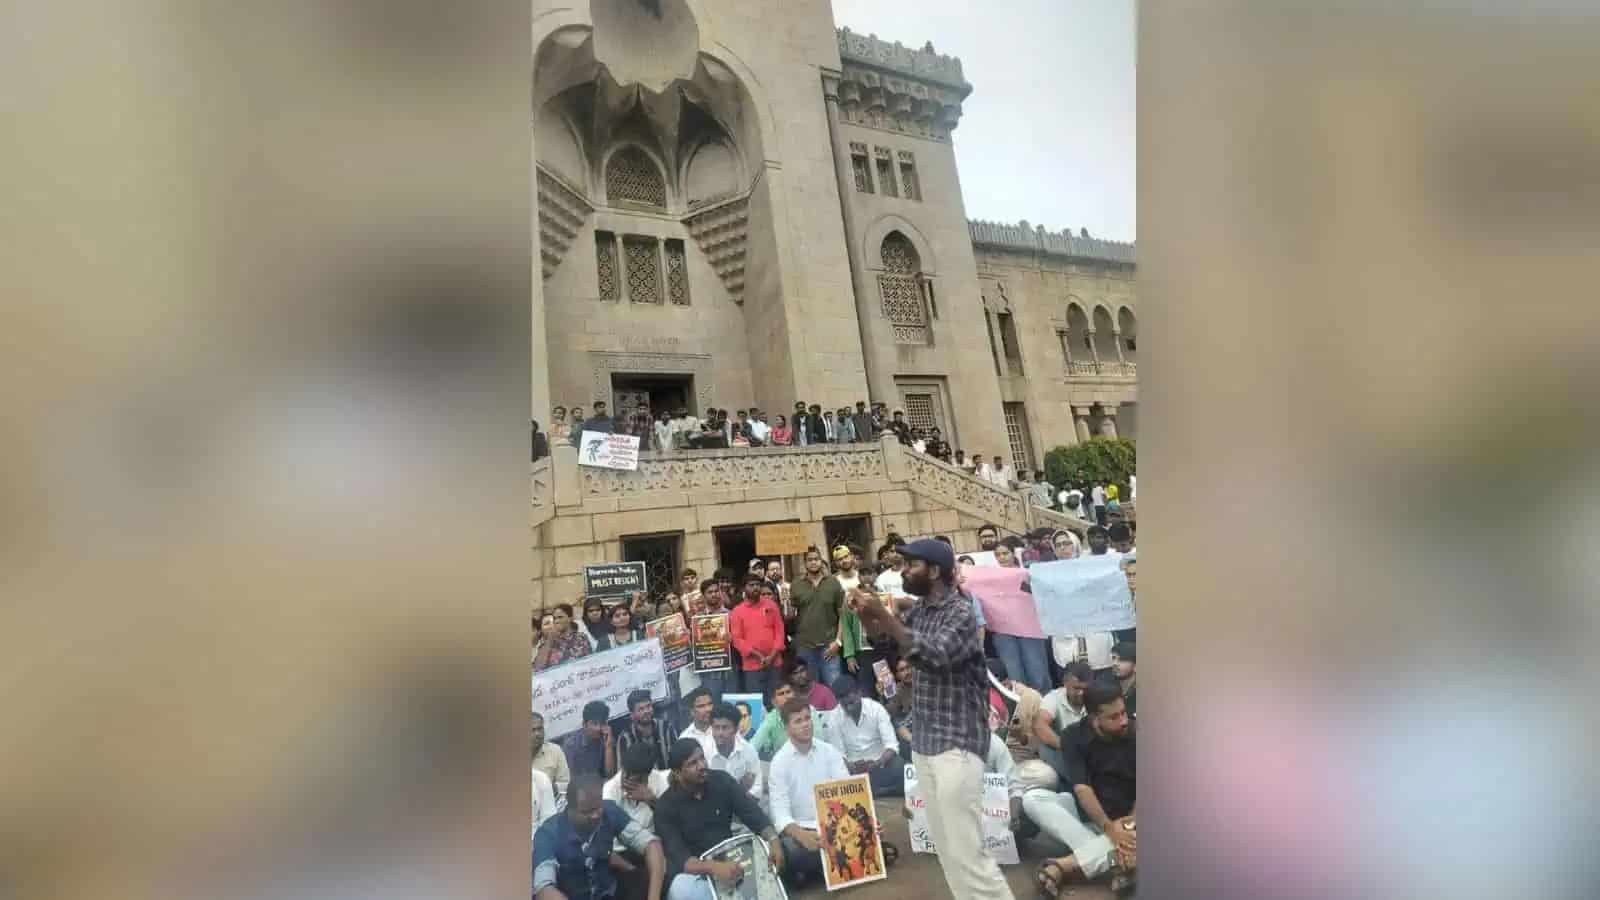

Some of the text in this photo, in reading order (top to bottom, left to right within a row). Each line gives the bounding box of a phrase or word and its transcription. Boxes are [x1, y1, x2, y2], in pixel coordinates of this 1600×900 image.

[592, 577, 612, 588] MUST
[818, 783, 864, 799] NEW INDIA
